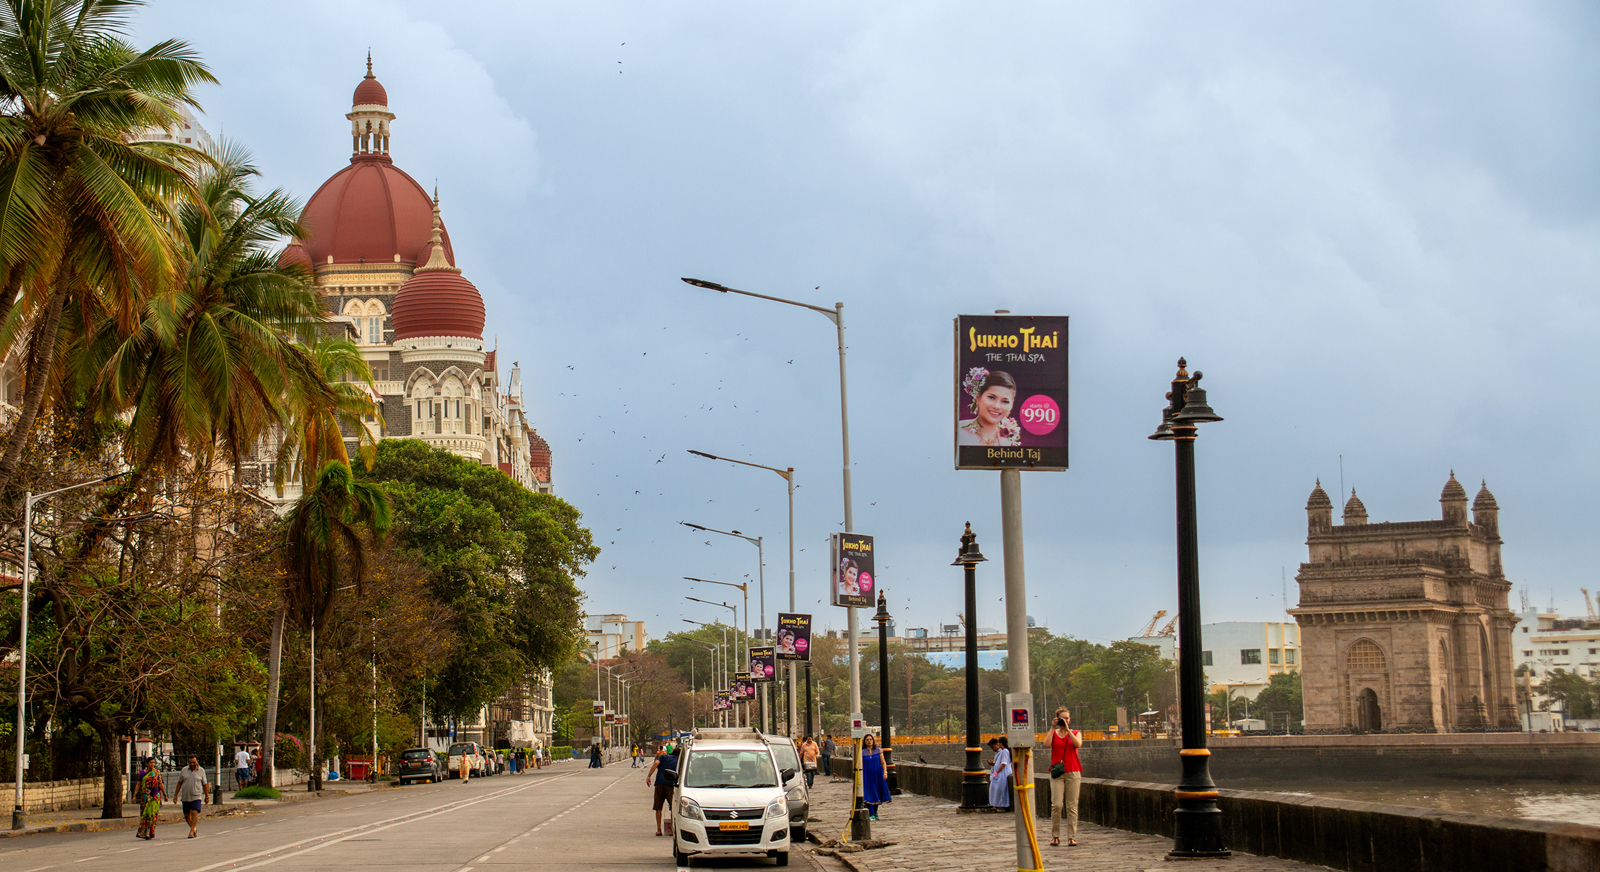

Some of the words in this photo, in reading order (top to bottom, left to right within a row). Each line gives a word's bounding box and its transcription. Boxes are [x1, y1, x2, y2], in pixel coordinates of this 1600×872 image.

[969, 326, 1018, 352] SUKHO
[985, 353, 1002, 362] THE
[1006, 353, 1026, 362] THAI
[1027, 353, 1045, 363] SPA
[987, 448, 1024, 459] Behind
[1026, 448, 1041, 461] Taj
